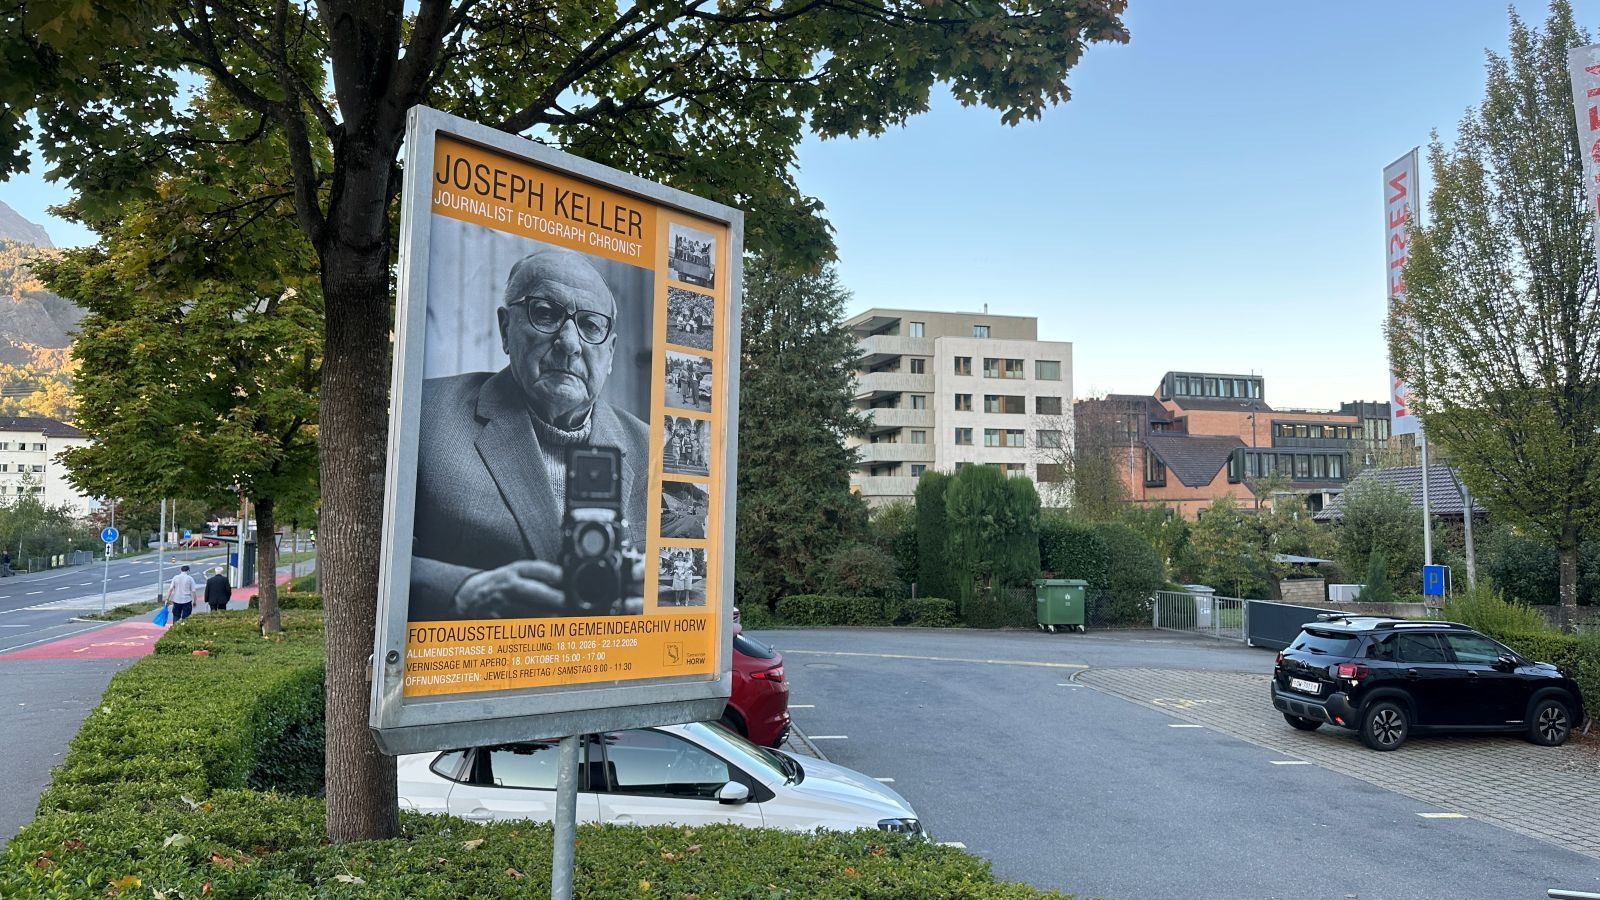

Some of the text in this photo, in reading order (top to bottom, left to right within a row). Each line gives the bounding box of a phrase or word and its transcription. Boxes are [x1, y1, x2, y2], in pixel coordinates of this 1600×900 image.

[436, 154, 642, 239] JOSEPH KELLER
[434, 190, 642, 257] JOURNALIST FOTOGRAPH CHRONIST
[1429, 571, 1438, 590] P
[408, 618, 707, 644] FOTOAUSSTELLUNG IM GEMEINDEARCHIV HORW
[406, 646, 486, 658] ALLMENDSTRASSE
[487, 645, 493, 654] 8
[579, 640, 596, 650] 2026
[406, 659, 461, 672] VERNISSAGE
[462, 658, 477, 669] MIT
[524, 654, 560, 665] OKTOBER
[562, 653, 581, 663] 15:00
[587, 651, 606, 661] 17:00
[686, 657, 706, 665] HORW
[405, 672, 481, 687] ÖFFNUNGSZEITEN:
[483, 670, 518, 681] JEWEILS
[519, 667, 551, 678] FREITAG
[557, 664, 592, 675] SAMSTAG
[593, 663, 608, 673] 9:00
